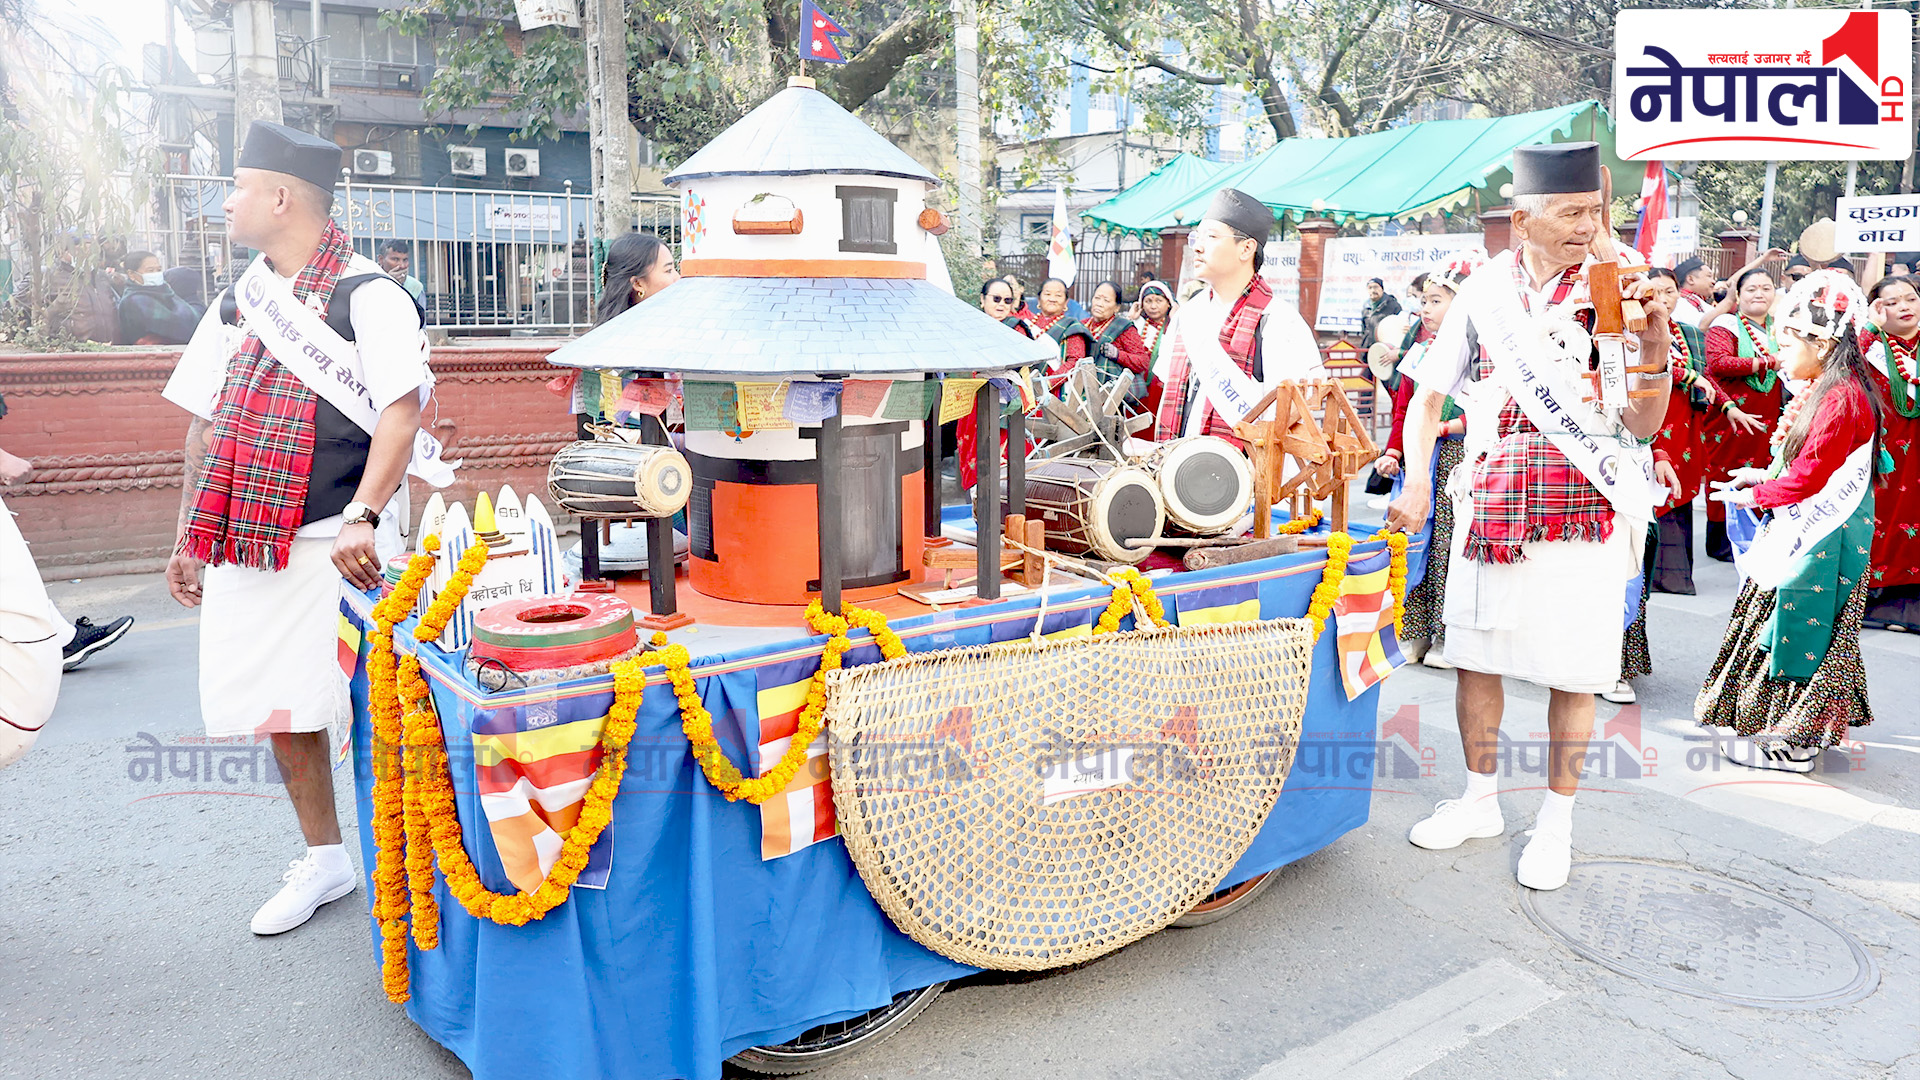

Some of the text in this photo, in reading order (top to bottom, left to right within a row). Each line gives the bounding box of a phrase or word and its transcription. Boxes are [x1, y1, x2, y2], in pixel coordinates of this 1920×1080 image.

[1858, 229, 1906, 243] नाच
[1381, 248, 1425, 262] मारवाडी
[1535, 384, 1562, 414] सेवा
[1560, 413, 1599, 454] समाज
